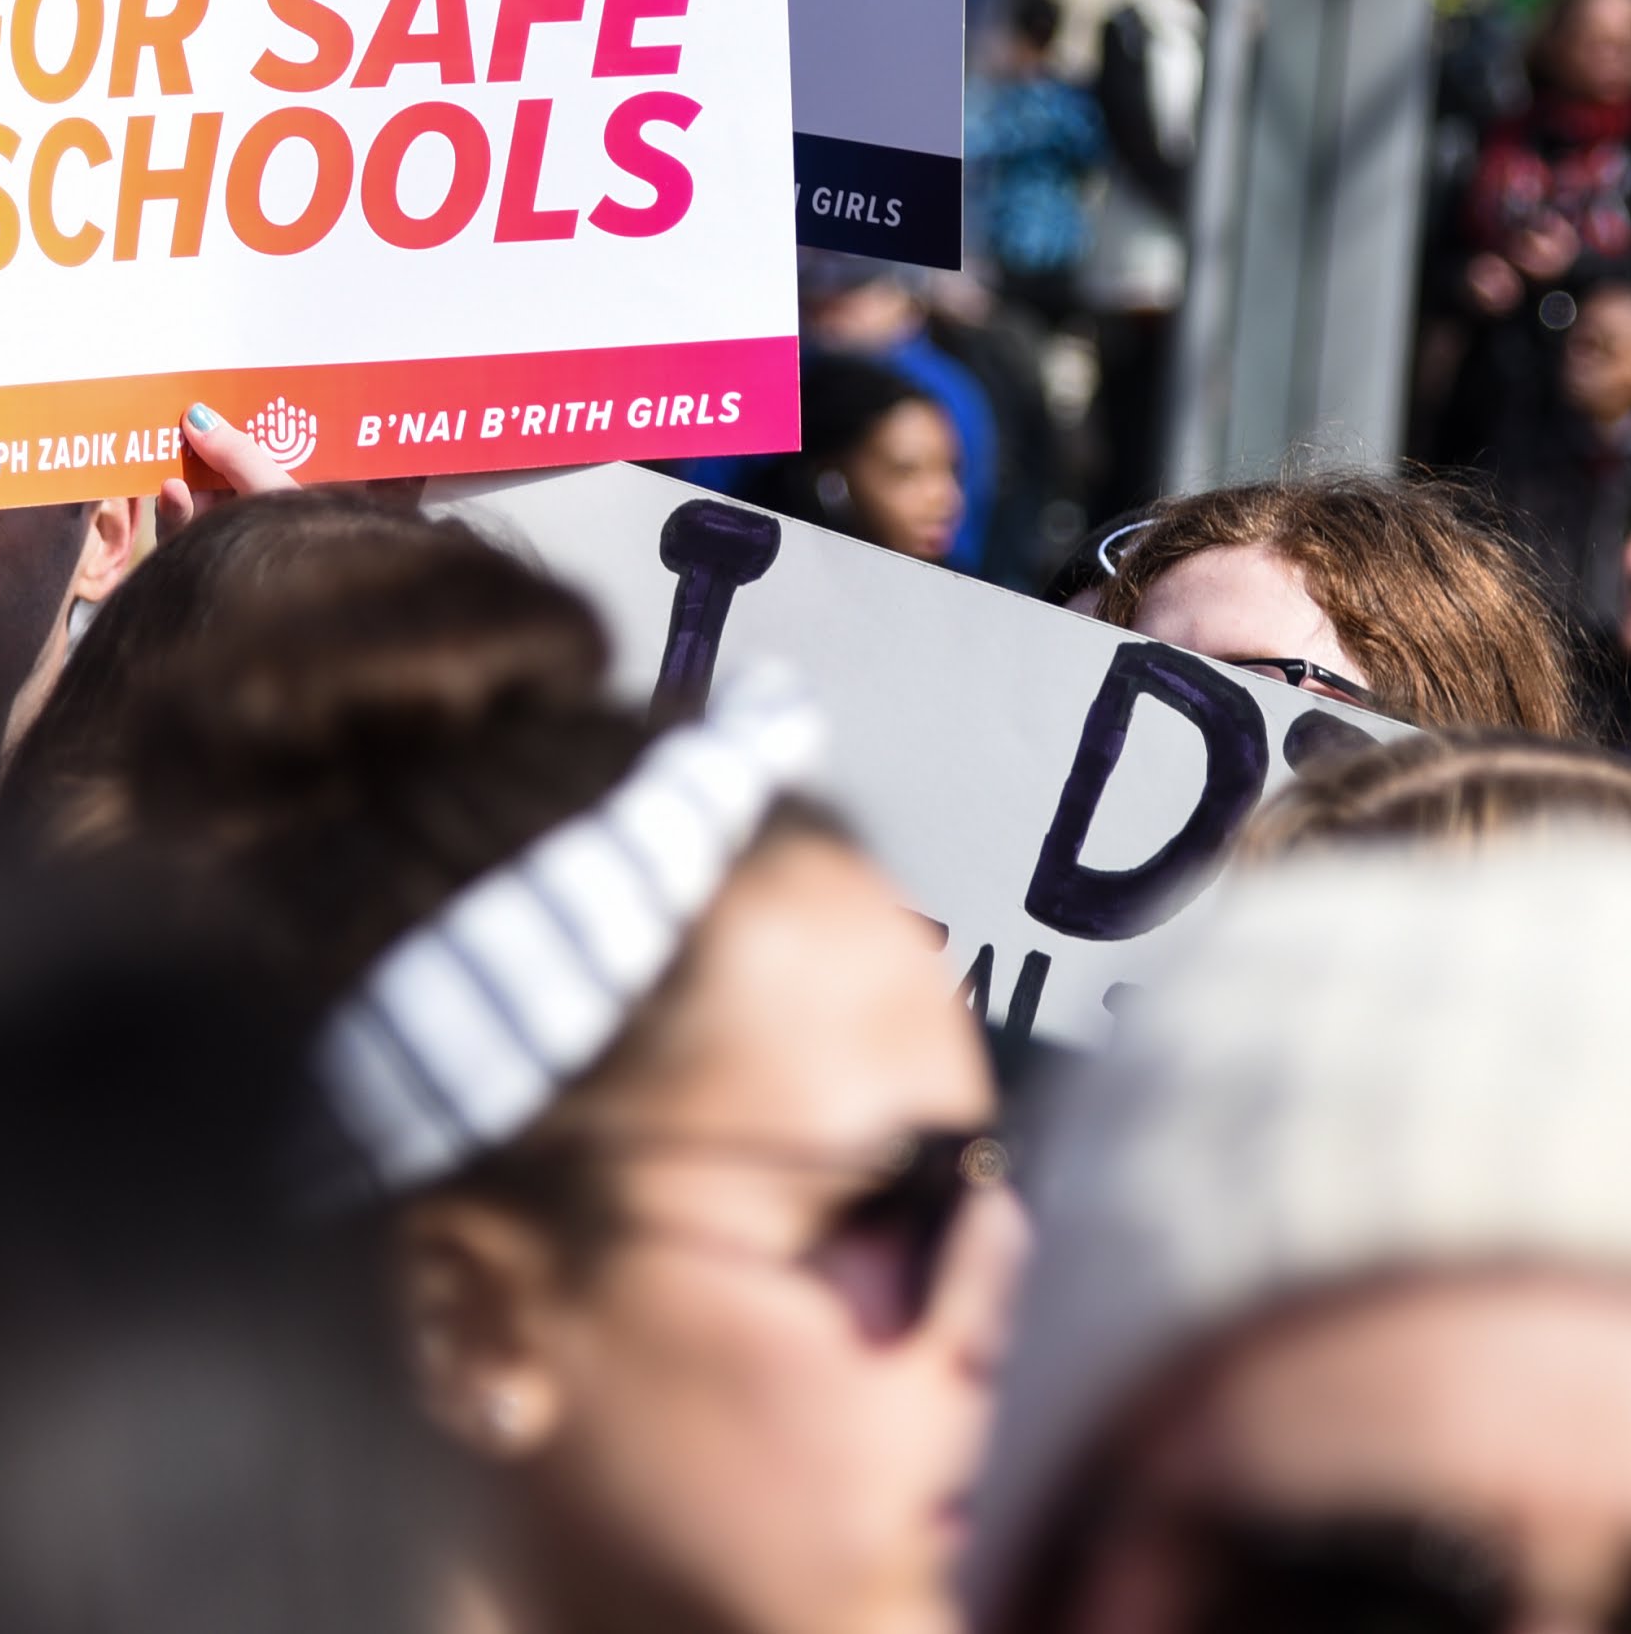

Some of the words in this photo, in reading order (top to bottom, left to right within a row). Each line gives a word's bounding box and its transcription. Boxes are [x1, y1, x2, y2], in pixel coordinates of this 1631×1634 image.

[812, 186, 903, 227] GIRLS
[356, 409, 467, 448] B’NAI
[479, 399, 614, 439] B’RITH
[626, 391, 743, 429] GIRLS
[38, 432, 117, 471] ZADIK
